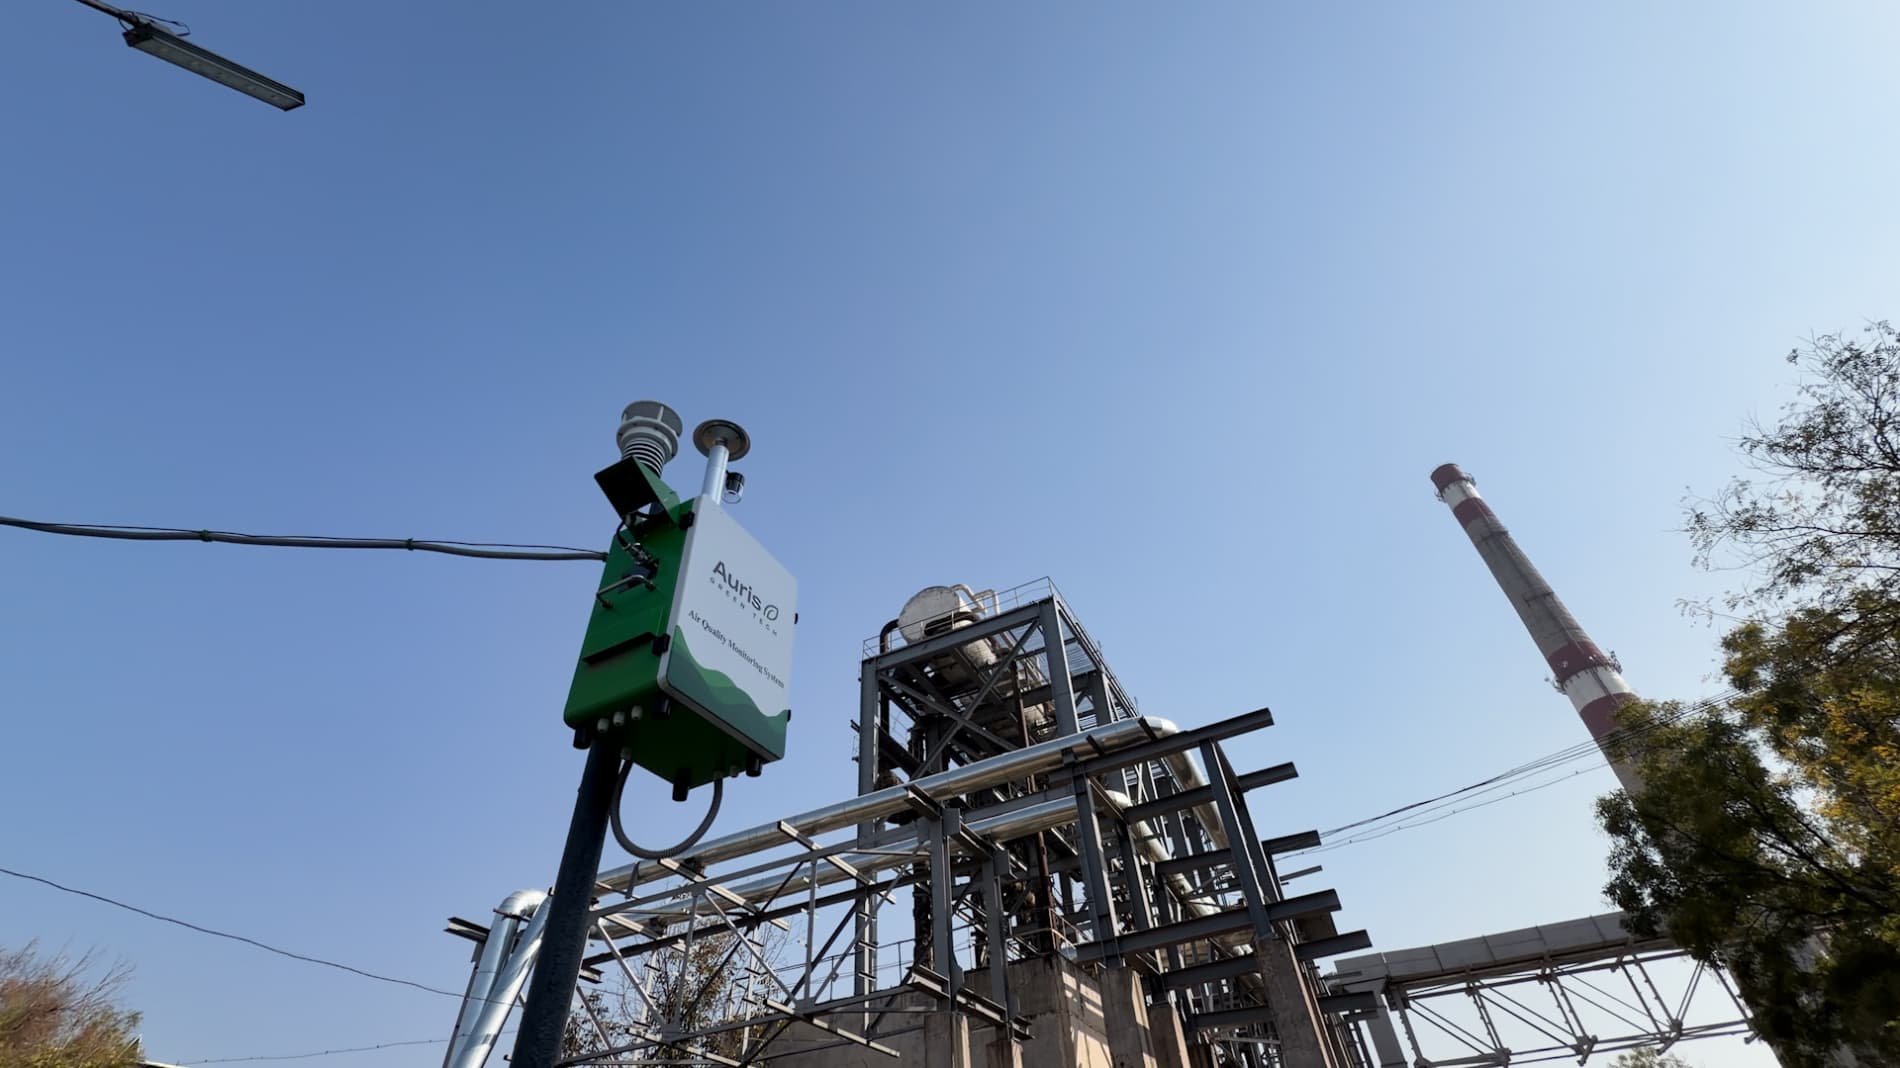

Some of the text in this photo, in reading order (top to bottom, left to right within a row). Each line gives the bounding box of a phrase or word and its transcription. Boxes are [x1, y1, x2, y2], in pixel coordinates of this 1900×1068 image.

[710, 577, 745, 609] GREEN
[712, 560, 761, 611] Auris
[688, 610, 785, 689] Air Quality Monitoring System
